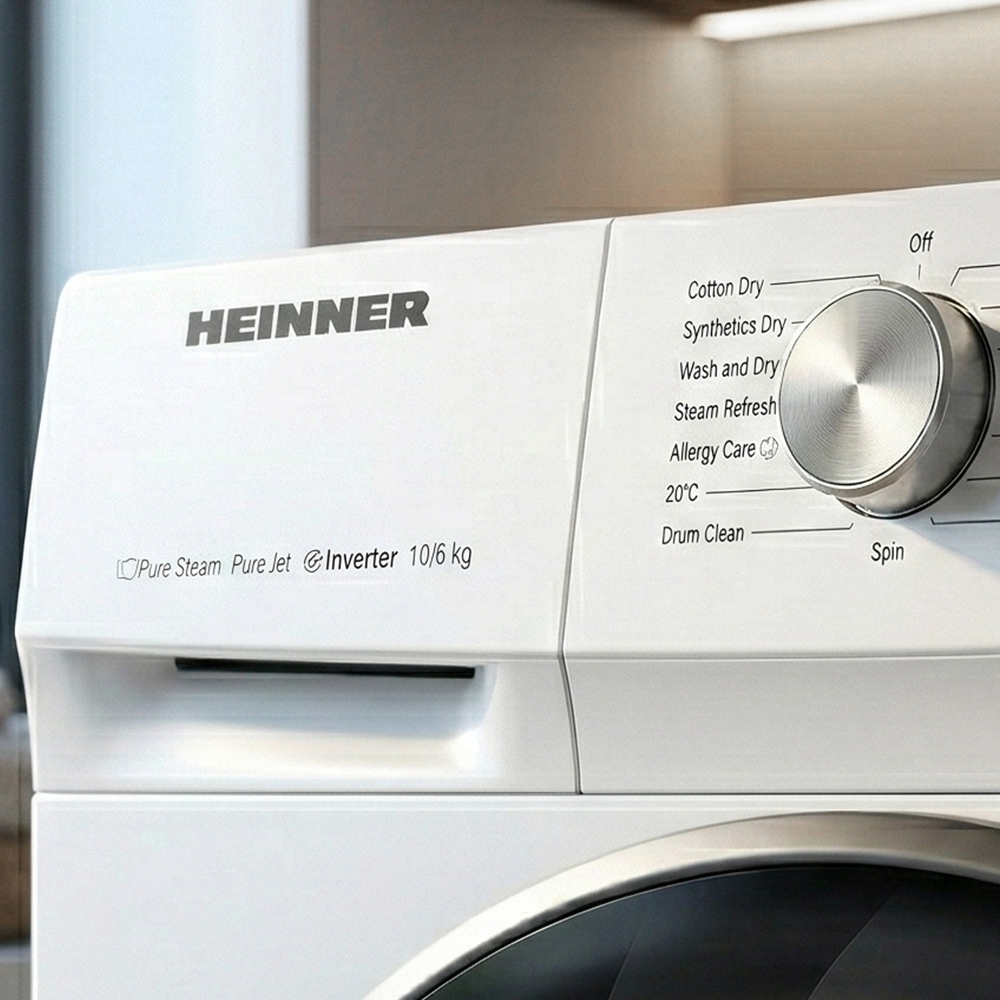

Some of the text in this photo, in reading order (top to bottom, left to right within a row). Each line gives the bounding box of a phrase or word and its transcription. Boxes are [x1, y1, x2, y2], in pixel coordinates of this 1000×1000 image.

[909, 230, 935, 253] Off
[687, 276, 765, 300] Cotton Dry
[185, 290, 430, 347] HEINNER
[682, 313, 788, 344] Synthetics Dry
[679, 356, 781, 380] Wash and Dry
[673, 395, 777, 422] Steam Refresh
[669, 438, 757, 466] Allergy Care
[664, 483, 700, 504] 20°C
[661, 522, 745, 545] Drum Clean
[138, 540, 475, 580] Pure Steam Pure Jet Inverter 10/6 kg
[870, 542, 905, 566] Spin
